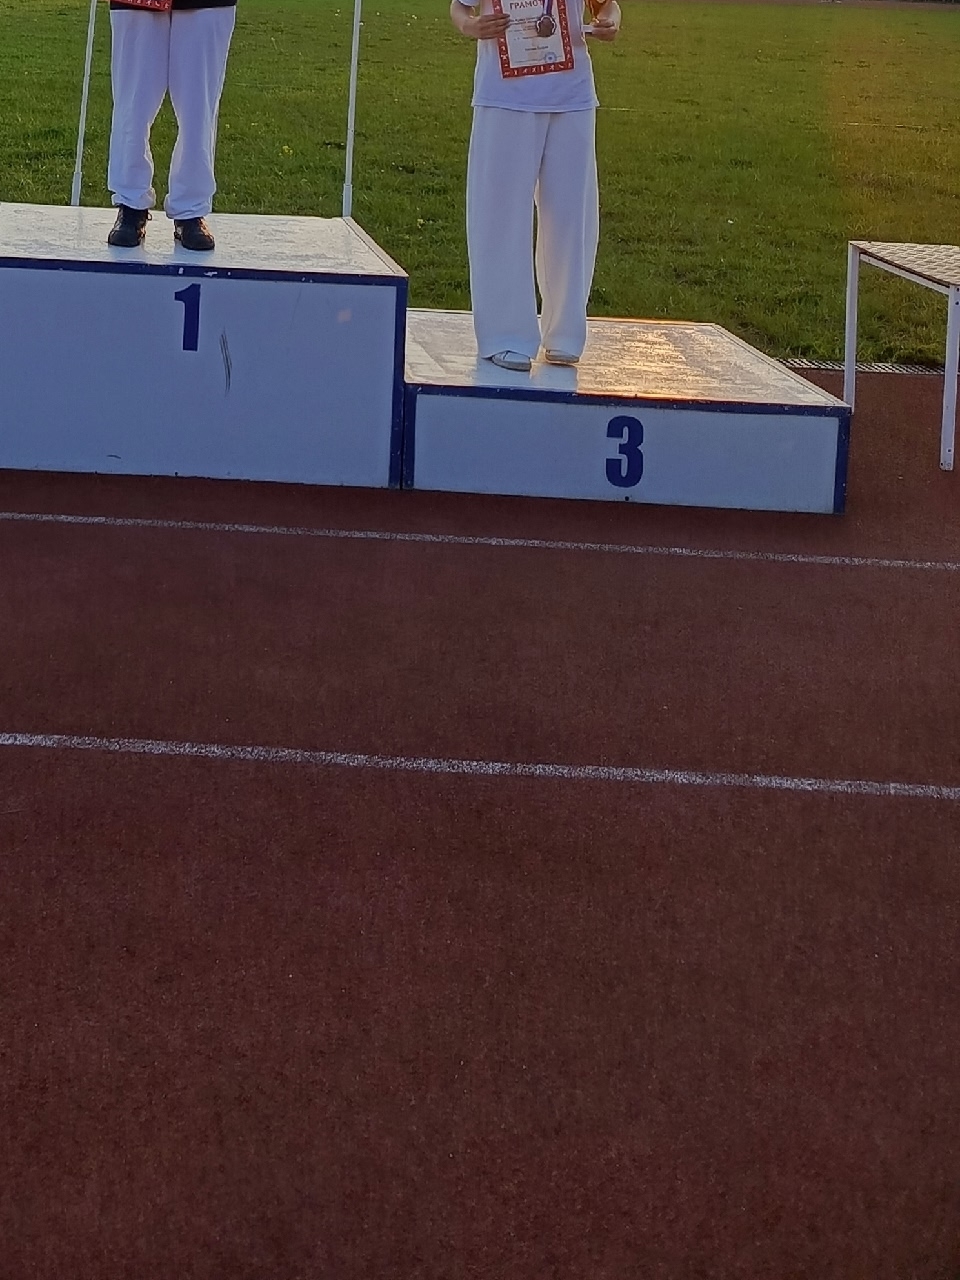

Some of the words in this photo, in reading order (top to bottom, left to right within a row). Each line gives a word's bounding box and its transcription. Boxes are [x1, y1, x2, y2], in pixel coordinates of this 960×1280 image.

[509, 0, 543, 10] ГРАМОТ
[174, 282, 202, 352] 1
[605, 415, 644, 489] 3
